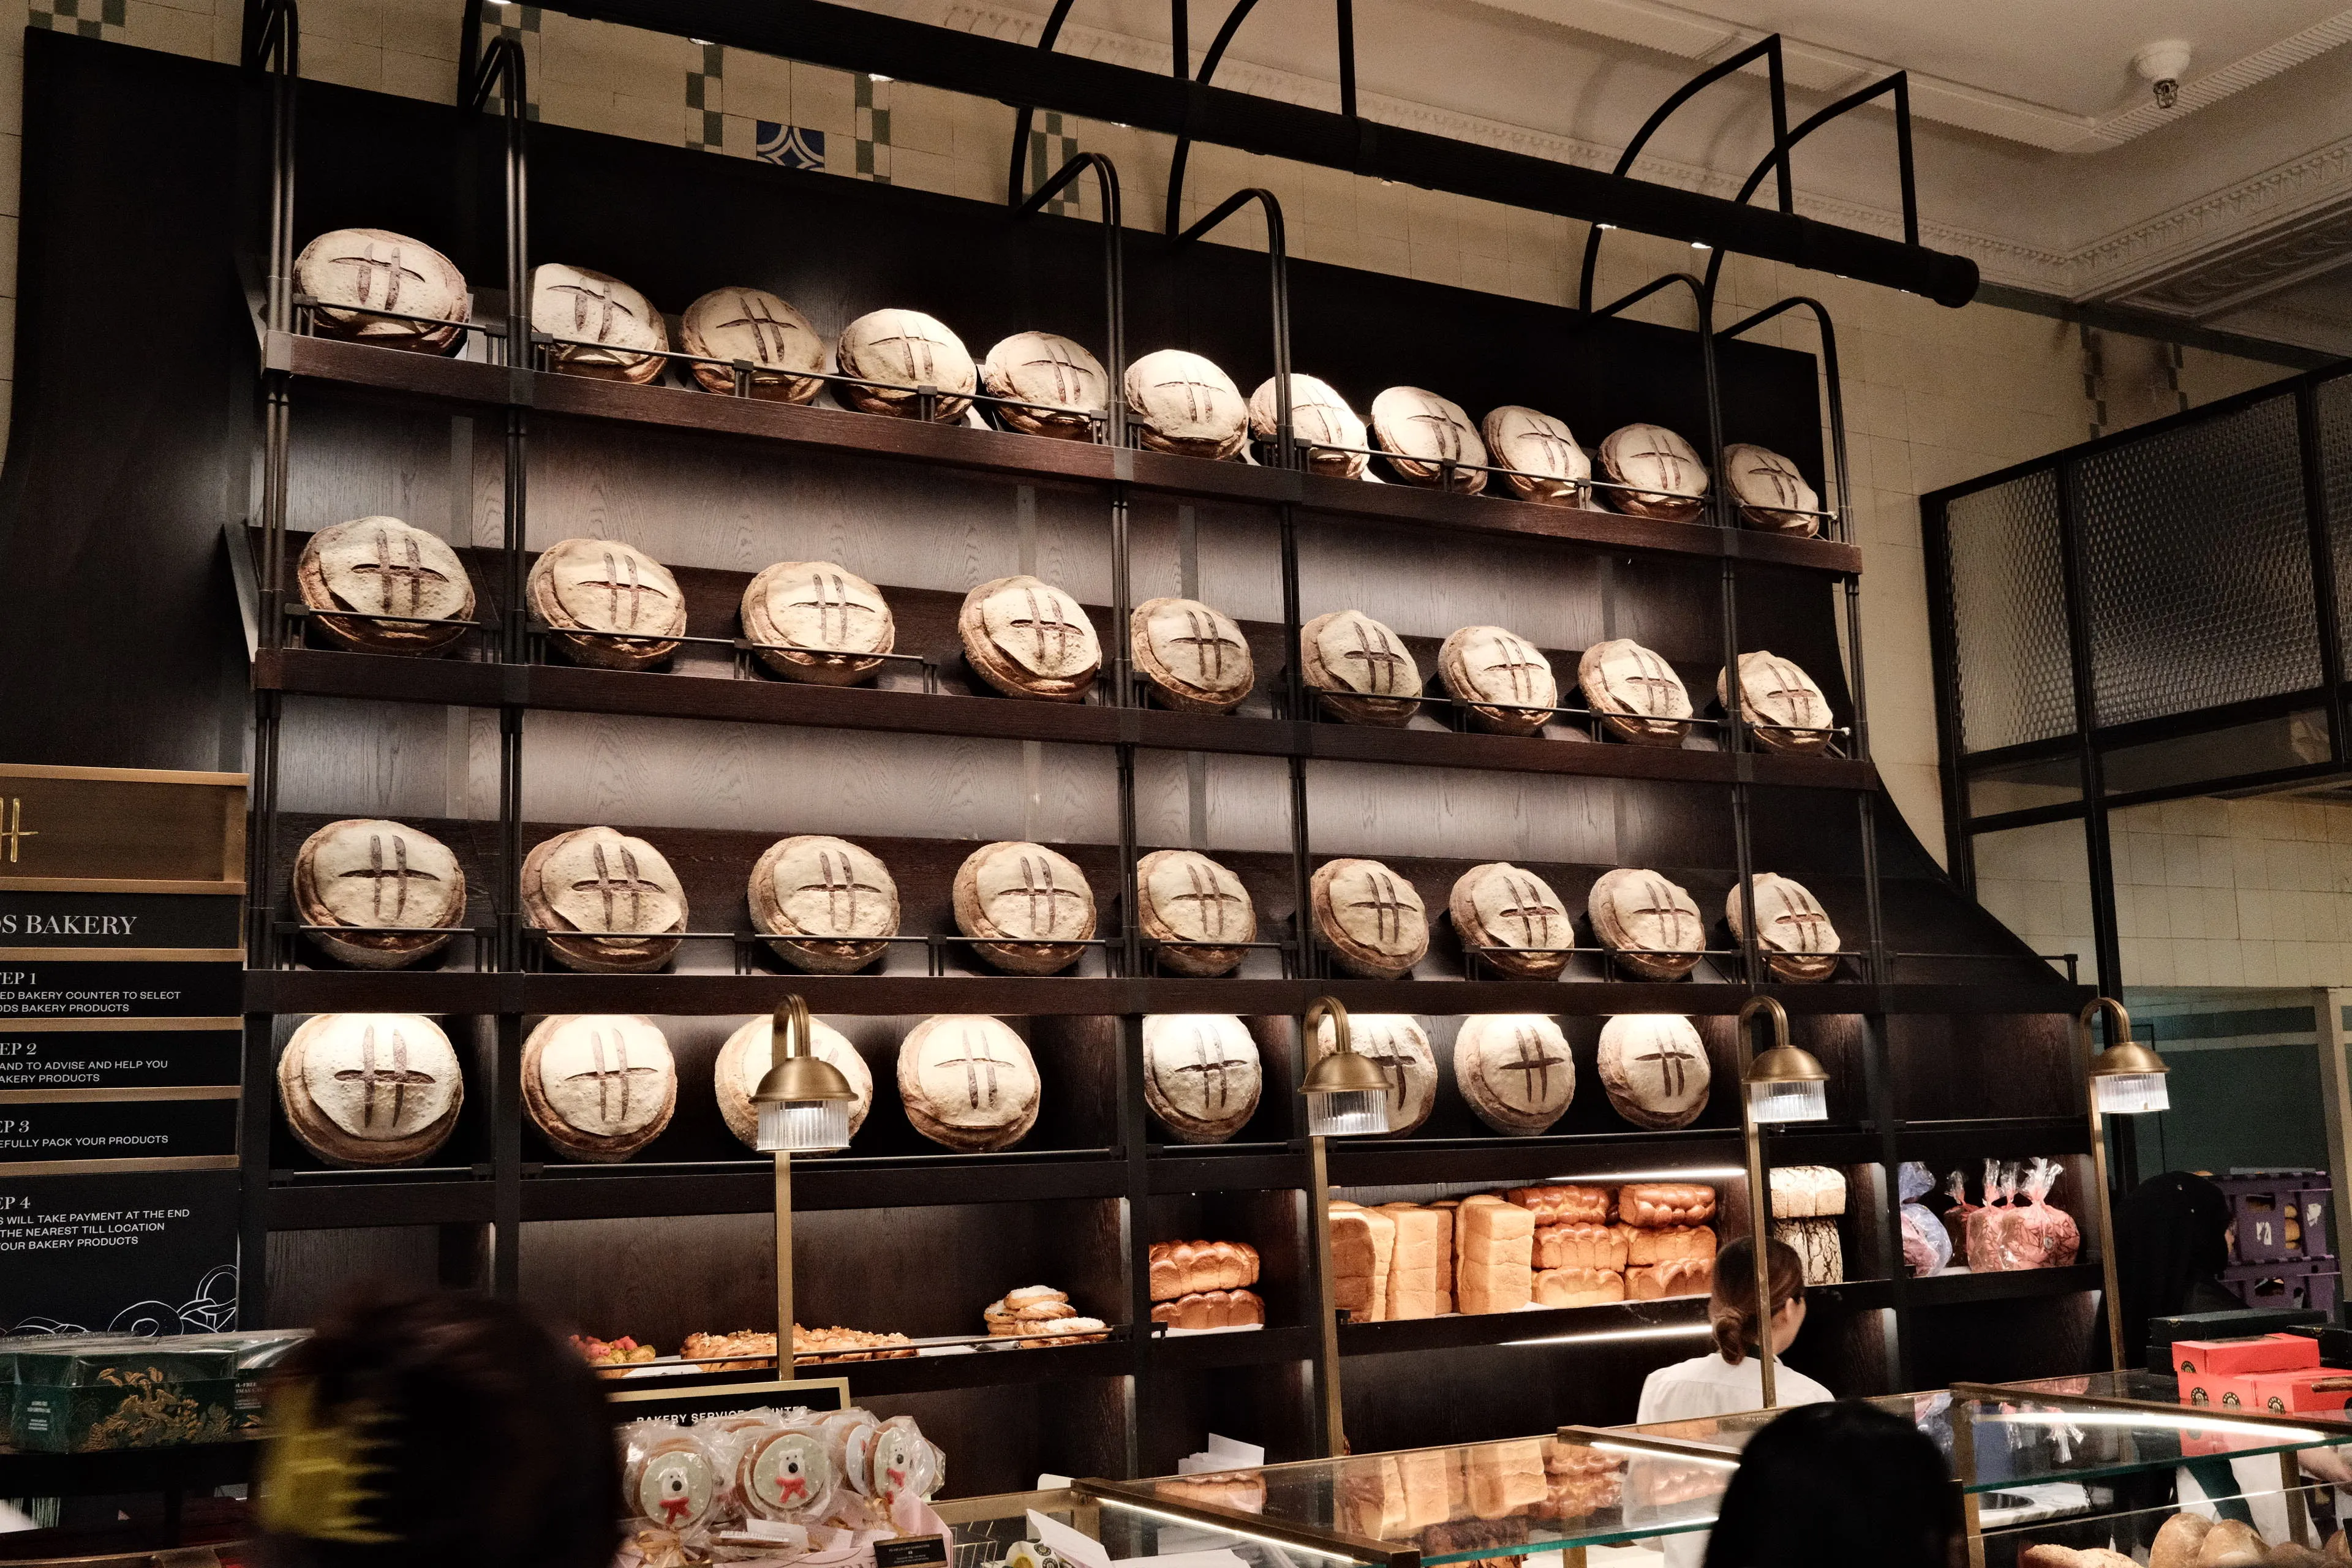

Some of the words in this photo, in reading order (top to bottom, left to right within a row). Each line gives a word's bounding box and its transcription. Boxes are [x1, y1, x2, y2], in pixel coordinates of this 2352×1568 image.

[0, 914, 17, 934] S
[24, 914, 137, 935] BAKERY
[0, 972, 25, 985] EP
[29, 972, 37, 986] 1
[18, 991, 63, 1000] BAKERY
[66, 991, 119, 1000] COUNTER
[122, 991, 138, 1000] TO
[140, 991, 181, 1000] SELECT
[0, 1004, 19, 1012] DS
[21, 1004, 66, 1012] BAKERY
[69, 1004, 129, 1012] PRODUCTS
[26, 1042, 37, 1055] 2
[0, 1062, 23, 1071] AND
[26, 1061, 42, 1070] TO
[44, 1061, 85, 1069] ADVISE
[88, 1061, 112, 1069] AND
[115, 1060, 143, 1069] HELP
[39, 1074, 100, 1082] PRODUCTS
[18, 1120, 29, 1133] 3
[42, 1138, 72, 1147] PACK
[75, 1137, 106, 1146] YOUR
[108, 1135, 168, 1145] PRODUCTS
[20, 1196, 31, 1209] 4
[6, 1215, 34, 1225] WILL
[37, 1214, 67, 1223] TAKE
[69, 1212, 123, 1222] PAYMENT
[125, 1211, 140, 1219] AT
[142, 1210, 165, 1219] THE
[167, 1208, 190, 1218] END
[0, 1229, 23, 1238] THE
[26, 1226, 79, 1237] NEAREST
[81, 1225, 105, 1234] TILL
[108, 1223, 165, 1233] LOCATION
[0, 1241, 26, 1251] OUR
[28, 1239, 75, 1250] BAKERY
[77, 1236, 138, 1247] PRODUCTS
